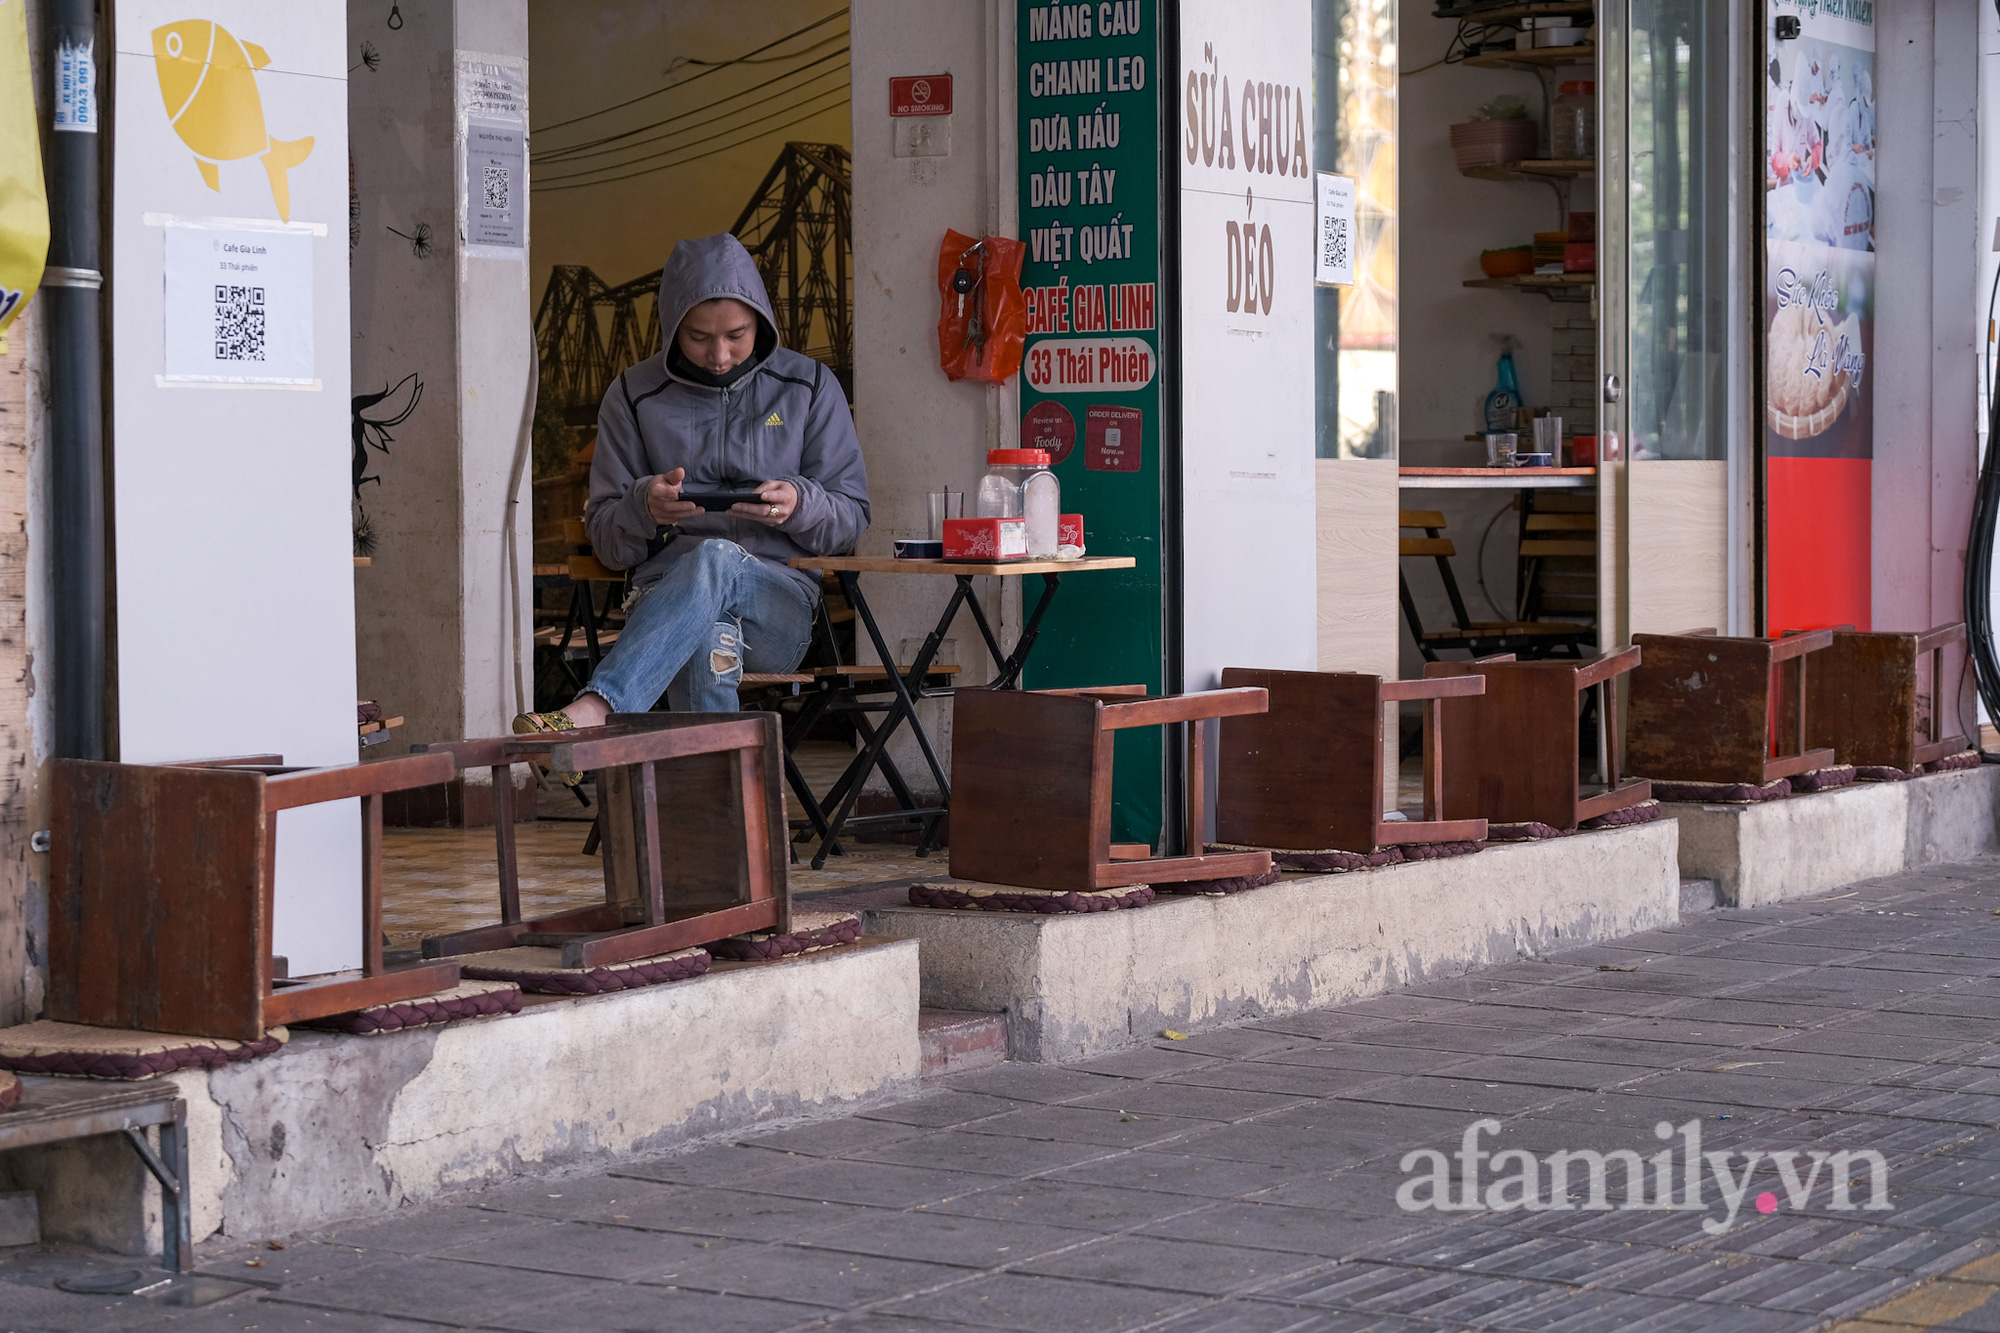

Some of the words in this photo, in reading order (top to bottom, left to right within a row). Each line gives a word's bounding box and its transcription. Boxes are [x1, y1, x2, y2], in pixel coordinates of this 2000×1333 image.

[1030, 58, 1101, 98] CHANH
[1106, 55, 1146, 92] LEO
[897, 105, 909, 113] NO
[910, 104, 945, 112] SMOKING
[1030, 113, 1072, 152] DƯA
[1077, 101, 1120, 150] HẤU
[1185, 41, 1236, 171] SỮA
[1241, 79, 1308, 179] CHUA
[1030, 165, 1072, 208] DÂU
[1077, 162, 1116, 206] TÂY
[223, 243, 238, 253] Cafe
[239, 244, 251, 254] Gia
[252, 245, 267, 255] Linh
[1030, 220, 1074, 270] VIỆT
[1079, 212, 1134, 264] QUẤT
[1225, 185, 1275, 317] DẺO
[219, 261, 227, 270] 33
[1022, 275, 1070, 335] CAFÉ
[1073, 284, 1107, 333] GIA
[1109, 282, 1156, 331] LINH
[1031, 348, 1052, 385] 33
[1057, 346, 1093, 384] Thái
[1099, 345, 1149, 383] Phiên
[1033, 417, 1053, 425] Review
[1088, 410, 1110, 418] ORDER
[1111, 411, 1139, 419] DELIVERY
[1034, 435, 1063, 452] Foody
[1101, 447, 1124, 456] Now.vn
